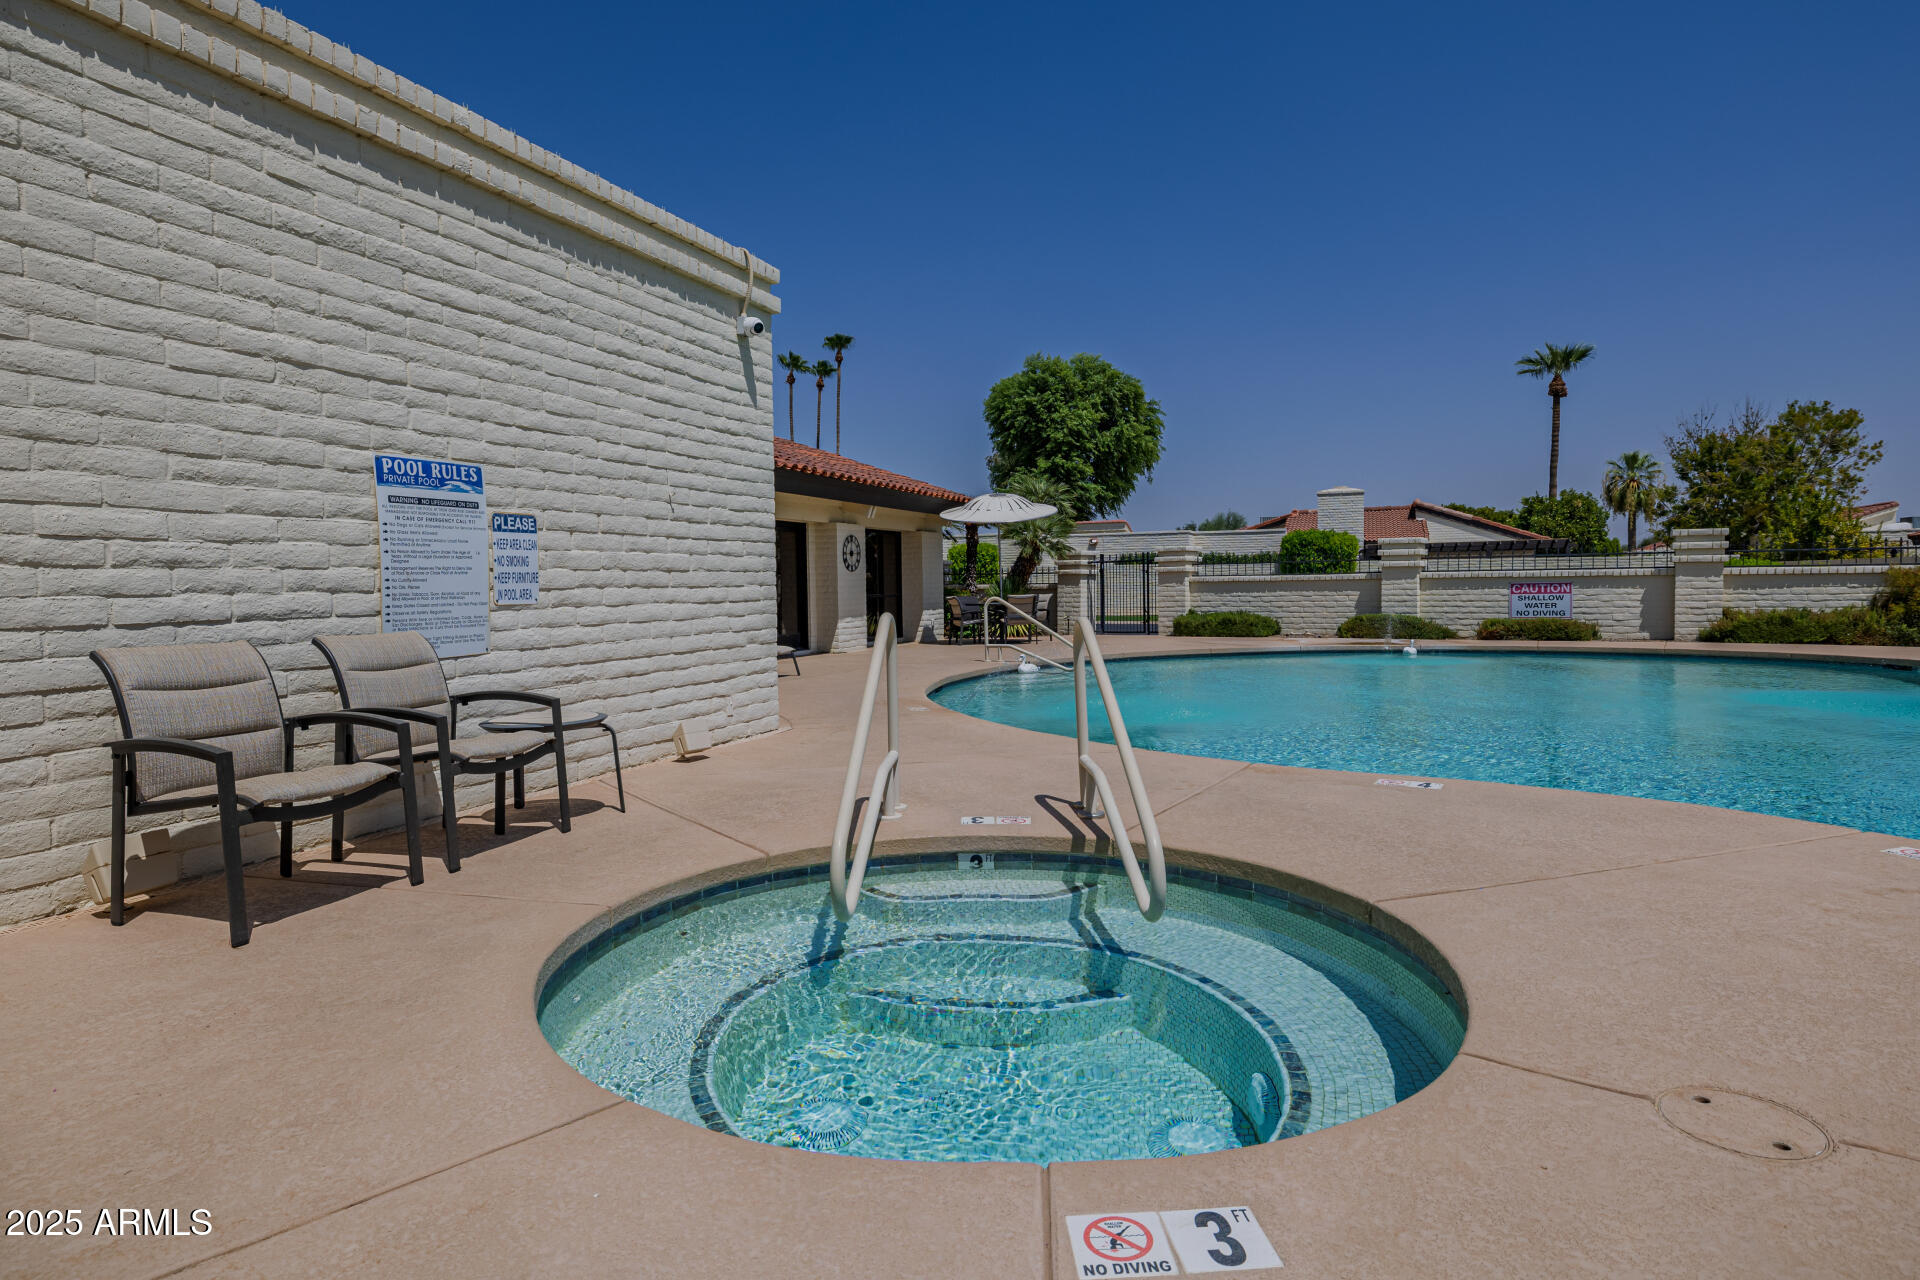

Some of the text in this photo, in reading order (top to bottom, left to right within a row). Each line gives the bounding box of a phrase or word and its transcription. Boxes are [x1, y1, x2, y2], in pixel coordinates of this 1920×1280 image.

[382, 458, 478, 482] POOL RULES
[383, 473, 440, 487] PRIVATE POOL
[390, 495, 419, 504] WARNING
[494, 516, 536, 531] PLEASE
[496, 538, 538, 551] KEEP AREA CLEAN
[497, 556, 530, 568] NO SMOKING
[498, 572, 539, 584] KEEP FURNITURE
[498, 588, 532, 601] IN POOL AREA
[1512, 584, 1570, 593] CAUTION
[970, 854, 992, 869] 3 FT
[1194, 1208, 1250, 1267] 3 FT
[1083, 1260, 1172, 1276] NO DIVING
